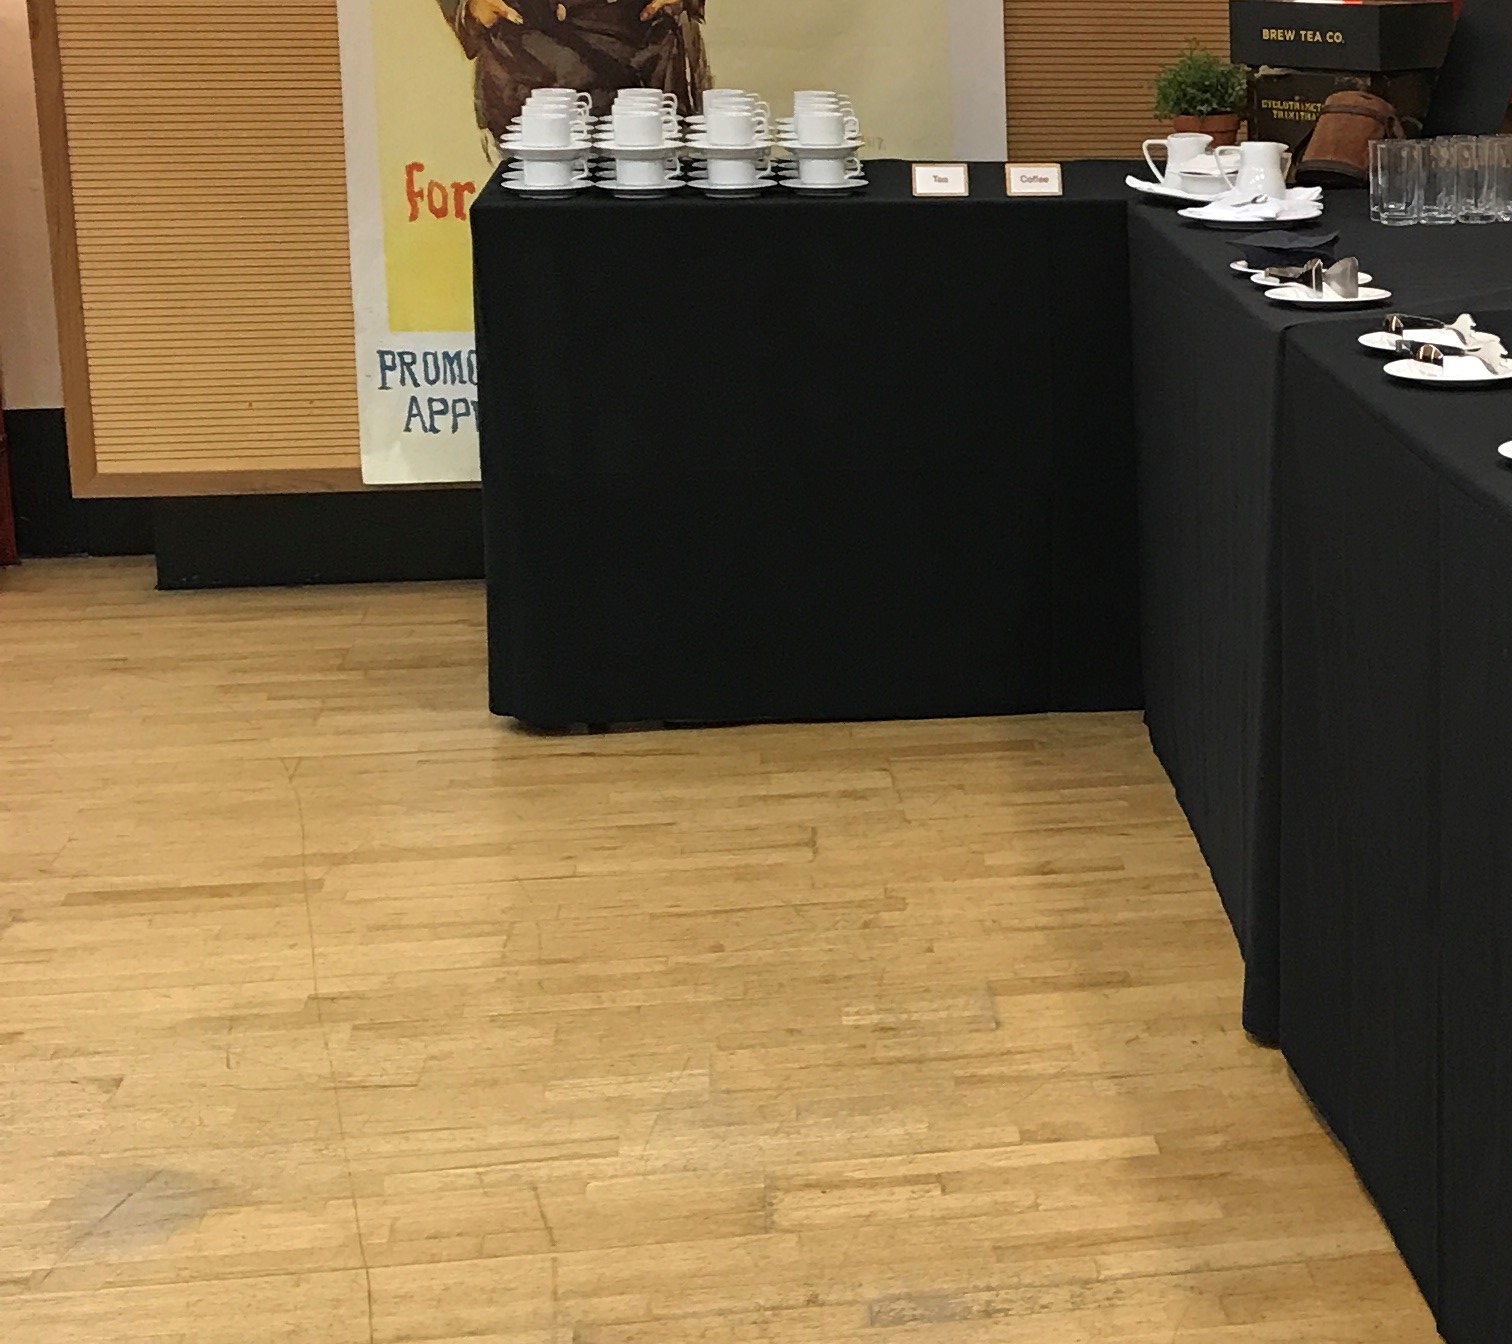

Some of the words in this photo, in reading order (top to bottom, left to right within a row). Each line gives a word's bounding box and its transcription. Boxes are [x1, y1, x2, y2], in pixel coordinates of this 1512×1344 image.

[1262, 29, 1296, 41] BREW
[1300, 30, 1323, 43] TEA
[1326, 31, 1345, 44] CO.
[932, 174, 949, 184] Tea
[1020, 174, 1050, 184] Coffee
